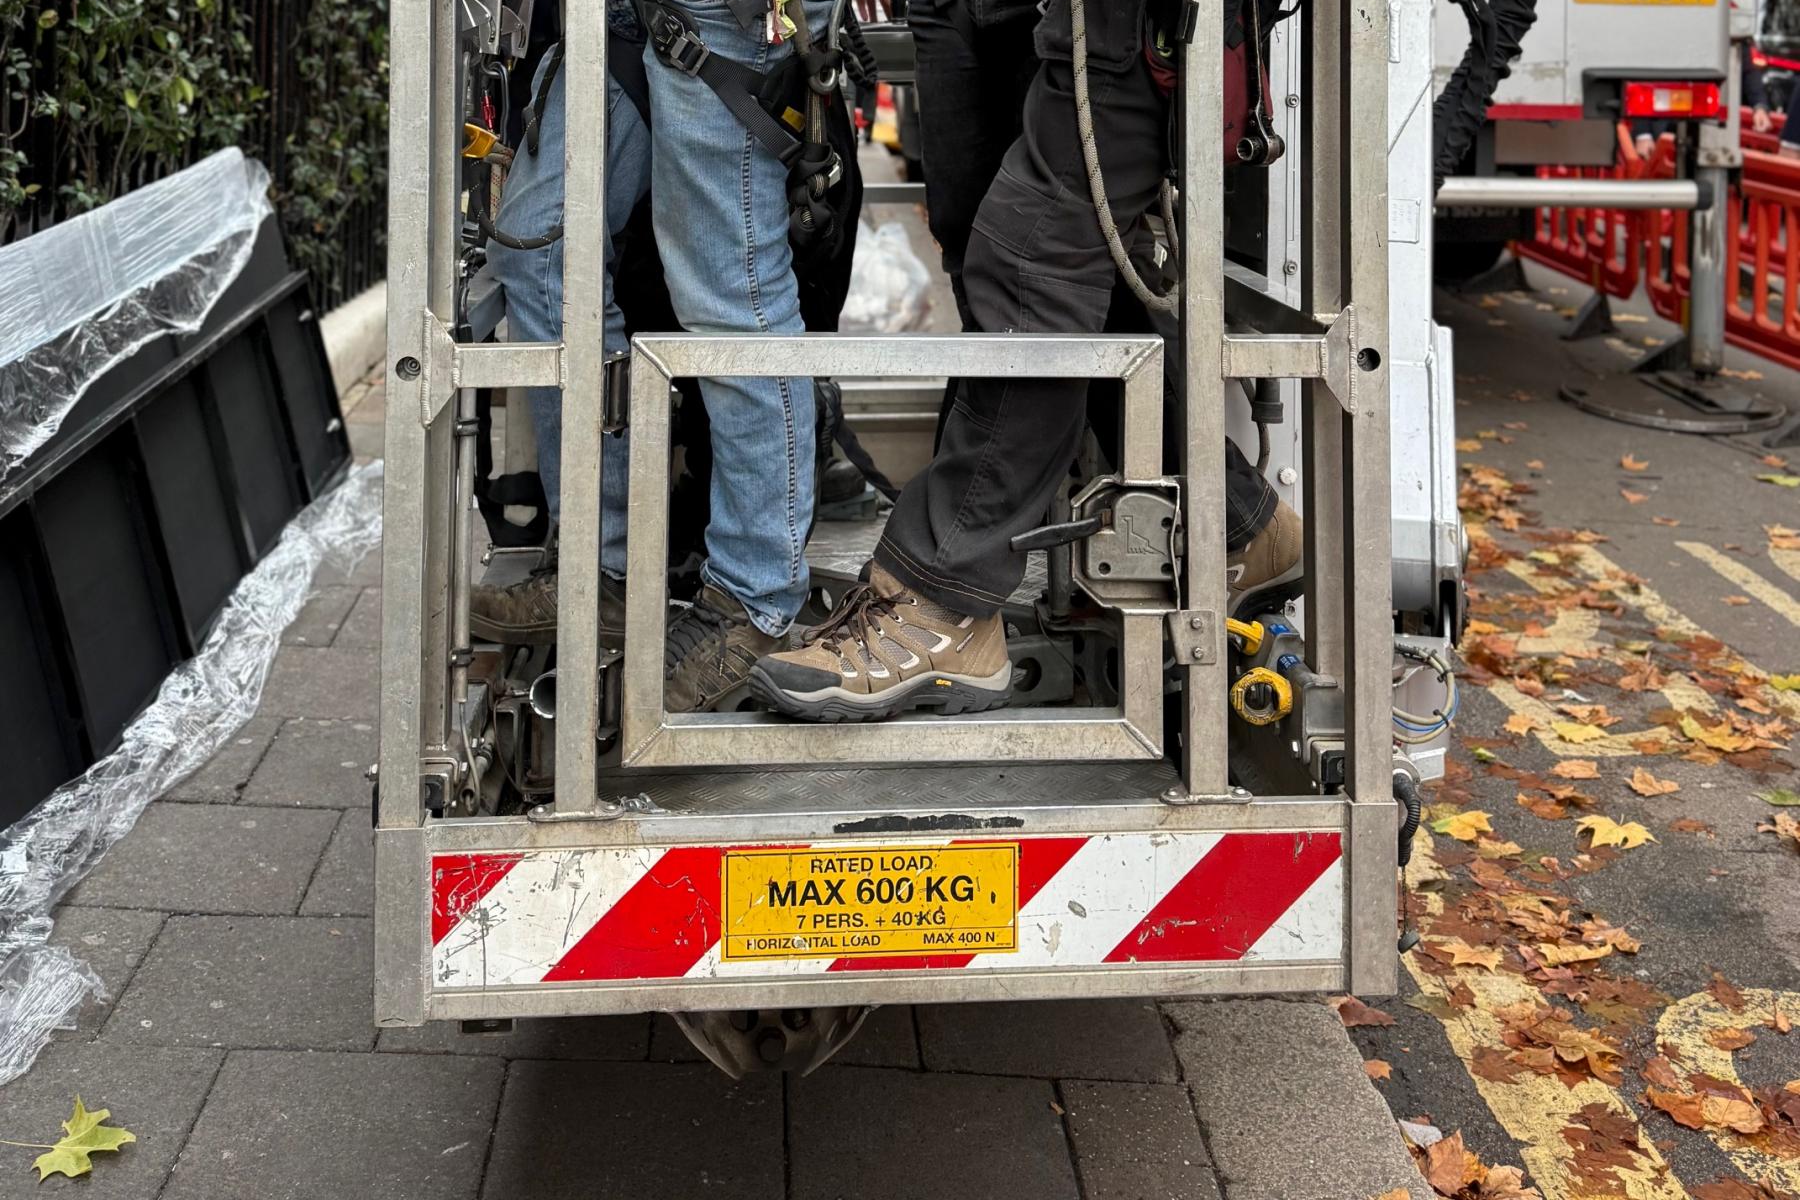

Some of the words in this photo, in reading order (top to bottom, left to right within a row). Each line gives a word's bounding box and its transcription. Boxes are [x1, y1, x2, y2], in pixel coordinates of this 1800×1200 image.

[810, 856, 874, 874] RATED
[880, 855, 933, 872] LOAD
[768, 878, 846, 908] MAX
[856, 876, 915, 905] 600
[925, 875, 974, 903] KG
[796, 914, 806, 929] 7
[813, 912, 869, 929] PERS.
[875, 915, 886, 928] +
[892, 911, 911, 927] 40
[916, 910, 946, 927] KG
[842, 934, 881, 948] LOAD
[923, 932, 954, 944] MAX
[958, 931, 982, 943] 400
[985, 931, 995, 943] N
